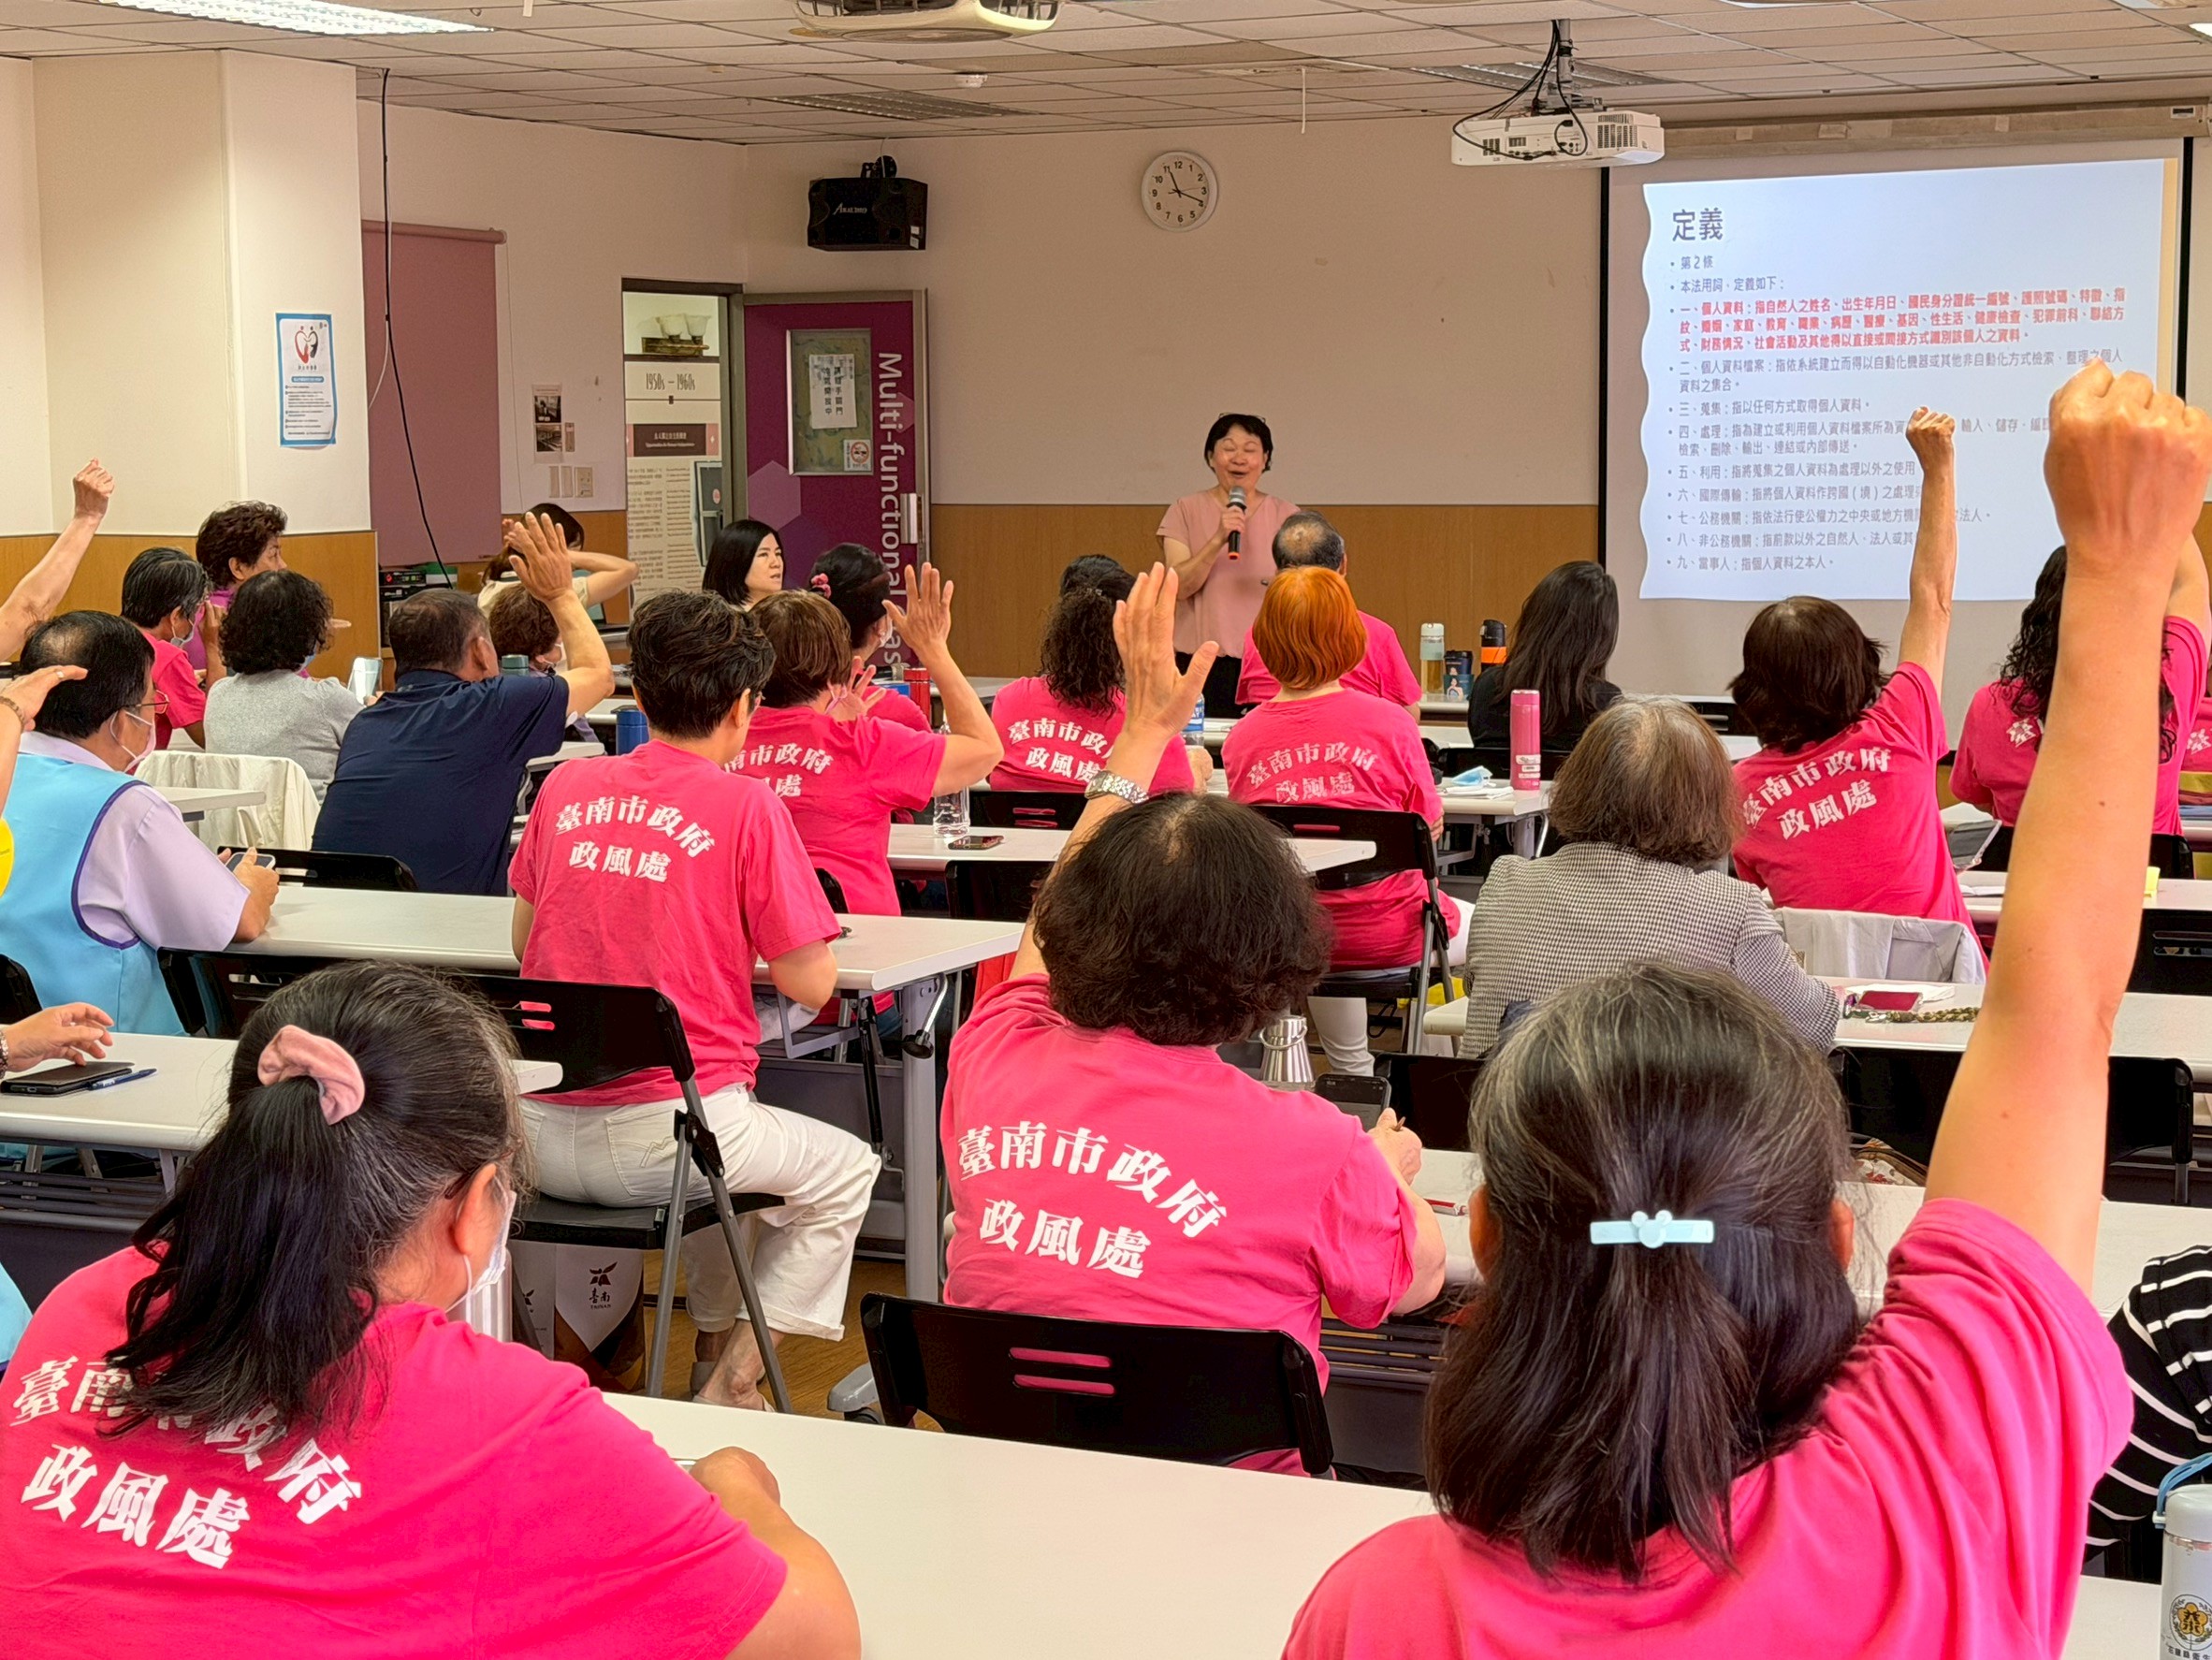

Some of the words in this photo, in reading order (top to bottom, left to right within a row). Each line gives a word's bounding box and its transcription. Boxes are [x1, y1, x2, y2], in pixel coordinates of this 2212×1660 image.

[1672, 208, 1723, 241] 定義
[878, 353, 906, 596] Multi-functional
[1008, 717, 1113, 759] 臺南市政
[1246, 741, 1377, 789] 臺南市政府
[1275, 771, 1355, 804] 政風處
[1742, 747, 1892, 829] 臺南市政府
[1776, 779, 1877, 840] 政風處
[555, 795, 716, 859] 臺南市政府
[568, 840, 672, 883] 政風處
[956, 1120, 1228, 1239] 臺南市政府
[979, 1198, 1152, 1279] 政風處
[9, 1354, 362, 1525] 臺南政府
[21, 1443, 251, 1570] 政風處
